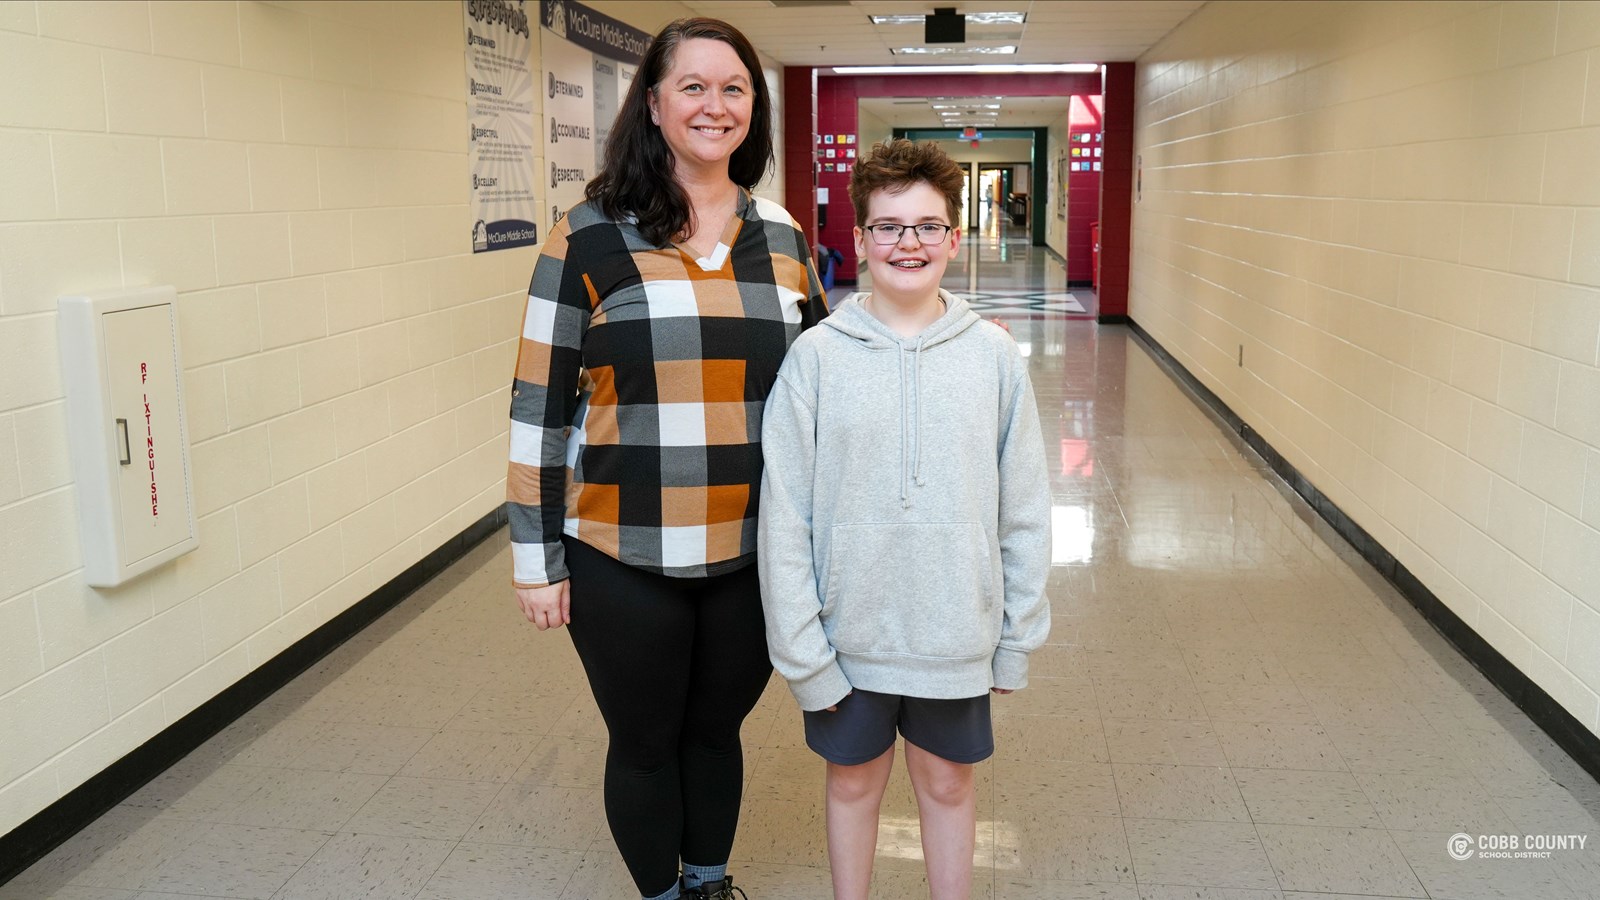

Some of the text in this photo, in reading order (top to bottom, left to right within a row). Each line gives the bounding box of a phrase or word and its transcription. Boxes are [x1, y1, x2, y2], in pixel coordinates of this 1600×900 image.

[468, 27, 495, 48] DETERMINED
[569, 8, 600, 40] McClure
[601, 22, 623, 49] Middle
[624, 32, 644, 56] School
[470, 78, 502, 95] ACCOUNTABLE
[548, 72, 583, 99] DETERMINED
[471, 123, 498, 141] RESPECTFUL
[551, 117, 590, 143] ACCOUNTABLE
[473, 174, 498, 189] EXCELLENT
[551, 161, 585, 188] RESPECTFUL
[487, 229, 535, 243] McClure Middle School
